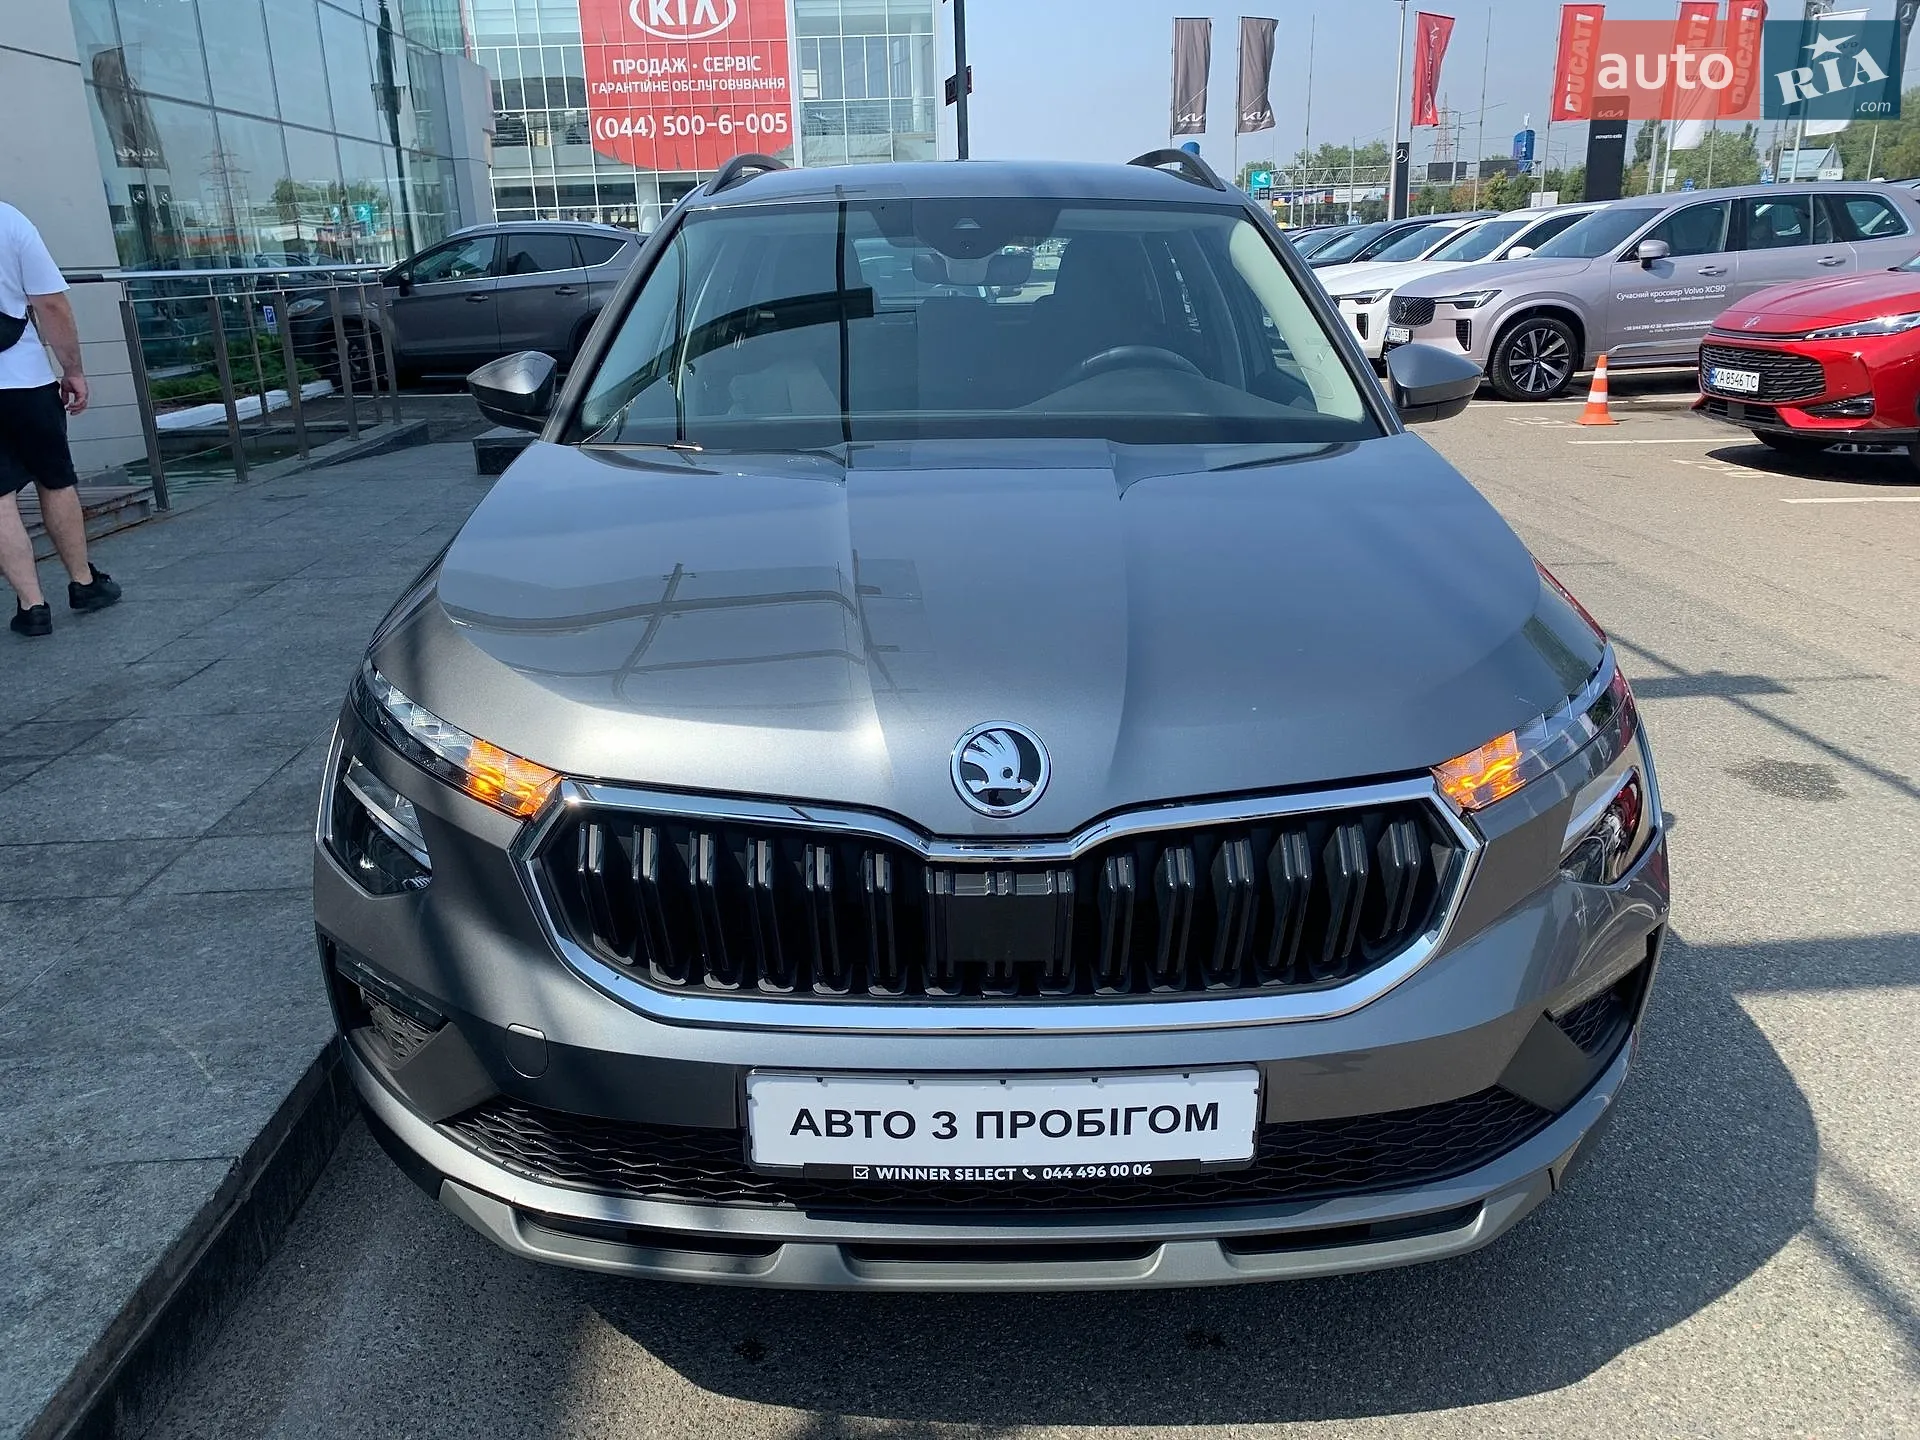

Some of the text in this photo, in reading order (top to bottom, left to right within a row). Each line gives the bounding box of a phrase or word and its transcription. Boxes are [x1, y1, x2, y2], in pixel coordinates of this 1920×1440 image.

[650, 0, 720, 26] KIA
[613, 55, 762, 77] ПРОДАЖ СЕРВІС
[1564, 13, 1594, 112] DUCATI
[592, 77, 786, 95] ГАРАНТІЙНЕ ОБСЛУГОВУВАННЯ
[595, 112, 788, 141] (044) 500-6-005
[1684, 287, 1704, 295] Volvo
[1726, 372, 1744, 387] 8546
[789, 1102, 1219, 1140] АВТО З ПРОБІГОМ
[876, 1164, 1153, 1181] WINNER SELECT 044 496 00 06
